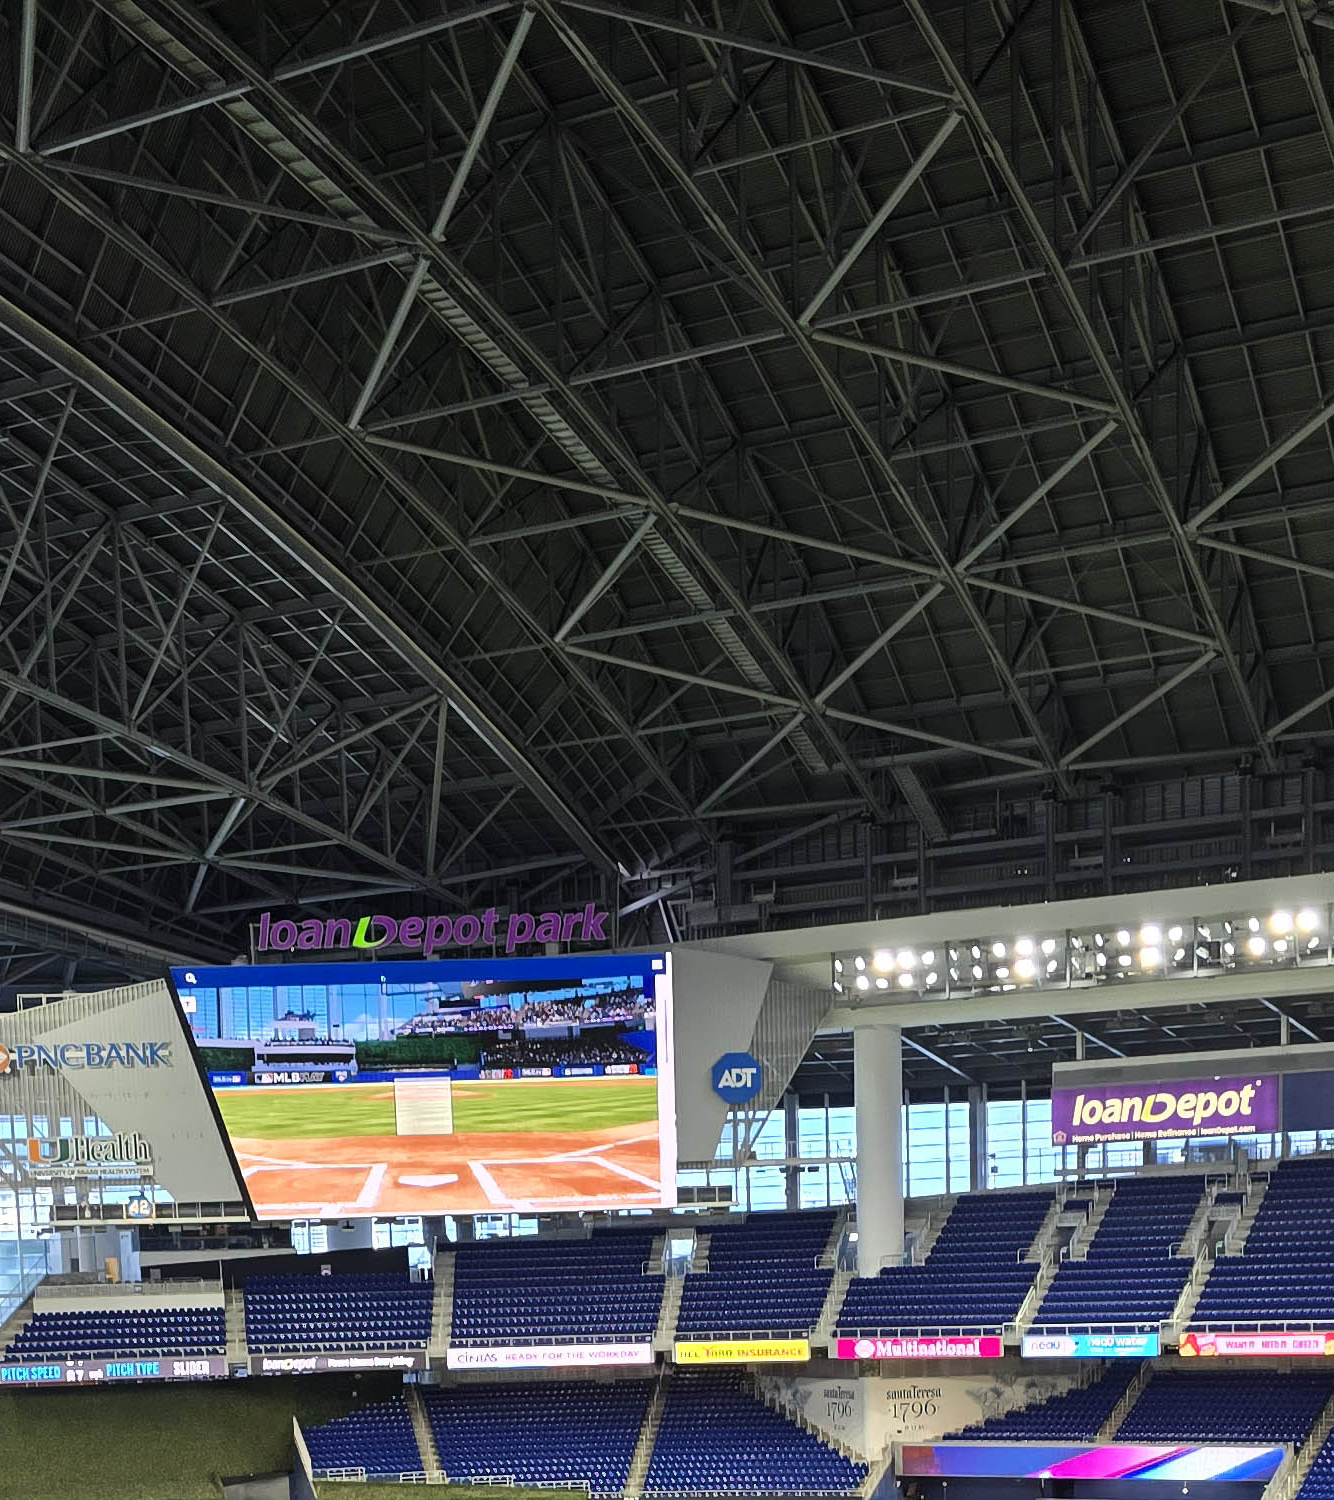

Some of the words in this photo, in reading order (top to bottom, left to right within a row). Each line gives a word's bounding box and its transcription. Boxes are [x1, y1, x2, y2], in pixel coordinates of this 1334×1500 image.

[257, 910, 504, 953] loanDepot
[505, 903, 610, 953] park
[718, 1067, 757, 1089] ADT
[1072, 1083, 1255, 1127] loanDepot
[505, 1352, 538, 1362] READY
[542, 1352, 562, 1361] FOR
[566, 1351, 585, 1361] THE
[588, 1350, 640, 1360] WORKDAY
[737, 1347, 804, 1358] INSURANCE
[875, 1339, 981, 1357] Multinational
[1, 1367, 31, 1381] PITCH
[32, 1365, 61, 1380] SPEED
[106, 1363, 134, 1377] PITCH
[135, 1361, 159, 1376] TYPE
[173, 1360, 210, 1376] SLIDER
[826, 1402, 853, 1421] 1796
[892, 1400, 937, 1419] 1796
